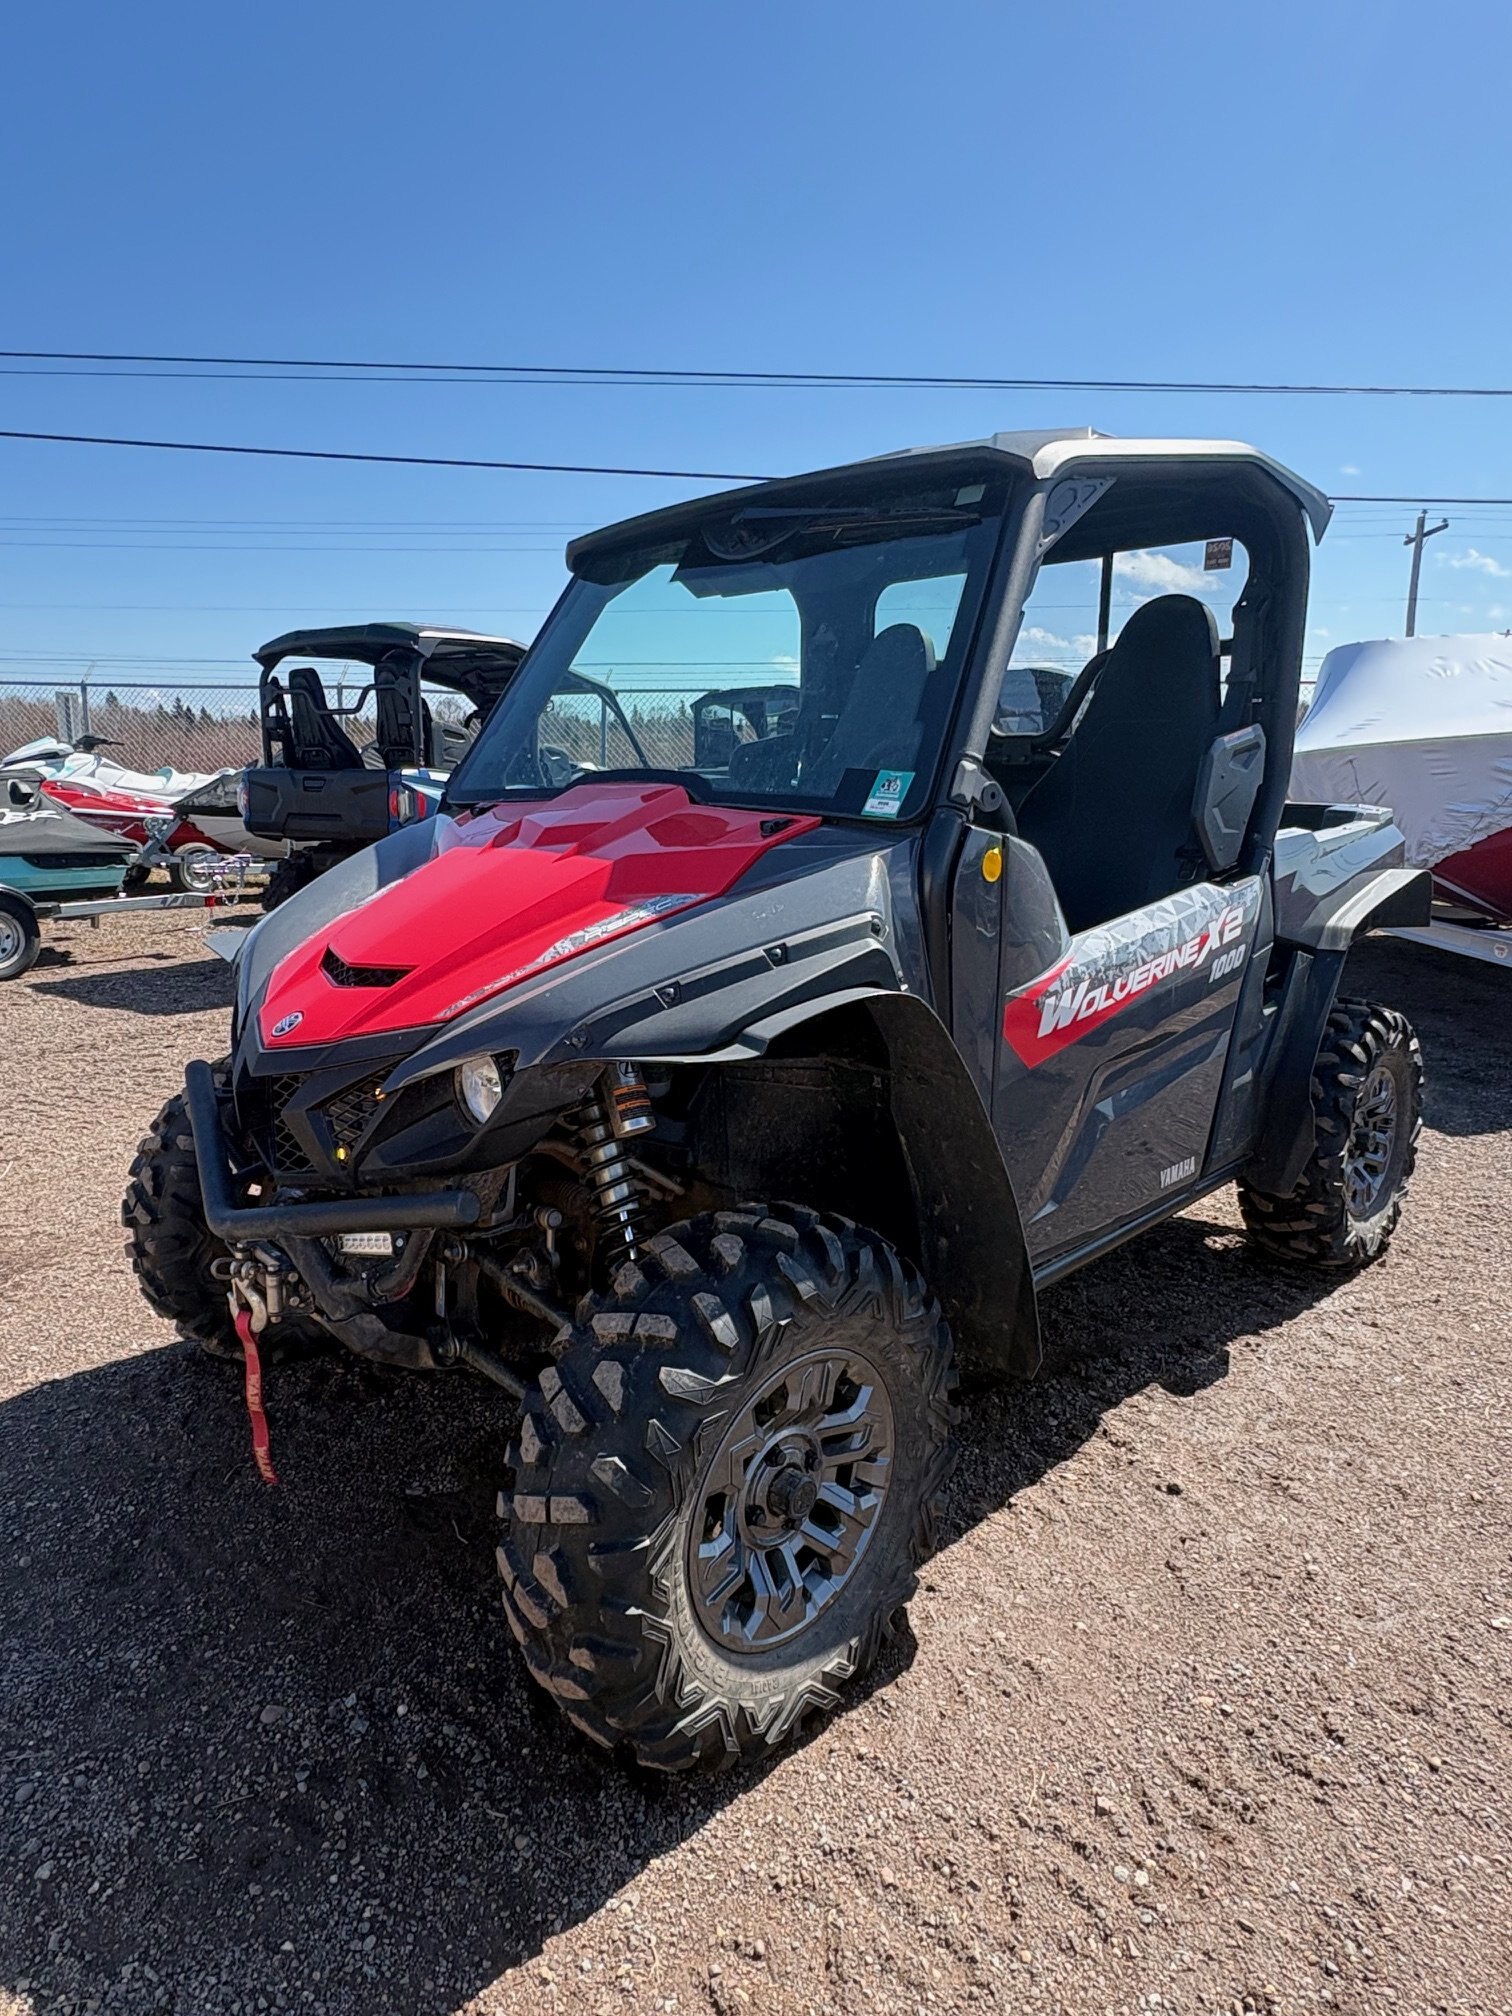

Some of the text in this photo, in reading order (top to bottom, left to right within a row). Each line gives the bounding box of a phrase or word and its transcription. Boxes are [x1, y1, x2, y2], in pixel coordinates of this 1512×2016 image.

[1037, 905, 1244, 1039] WOLVERINE X2
[1208, 943, 1247, 984] 1000
[1160, 1156, 1195, 1189] YAMAHA
[246, 1374, 262, 1412] WARN
[255, 1447, 276, 1480] WARN
